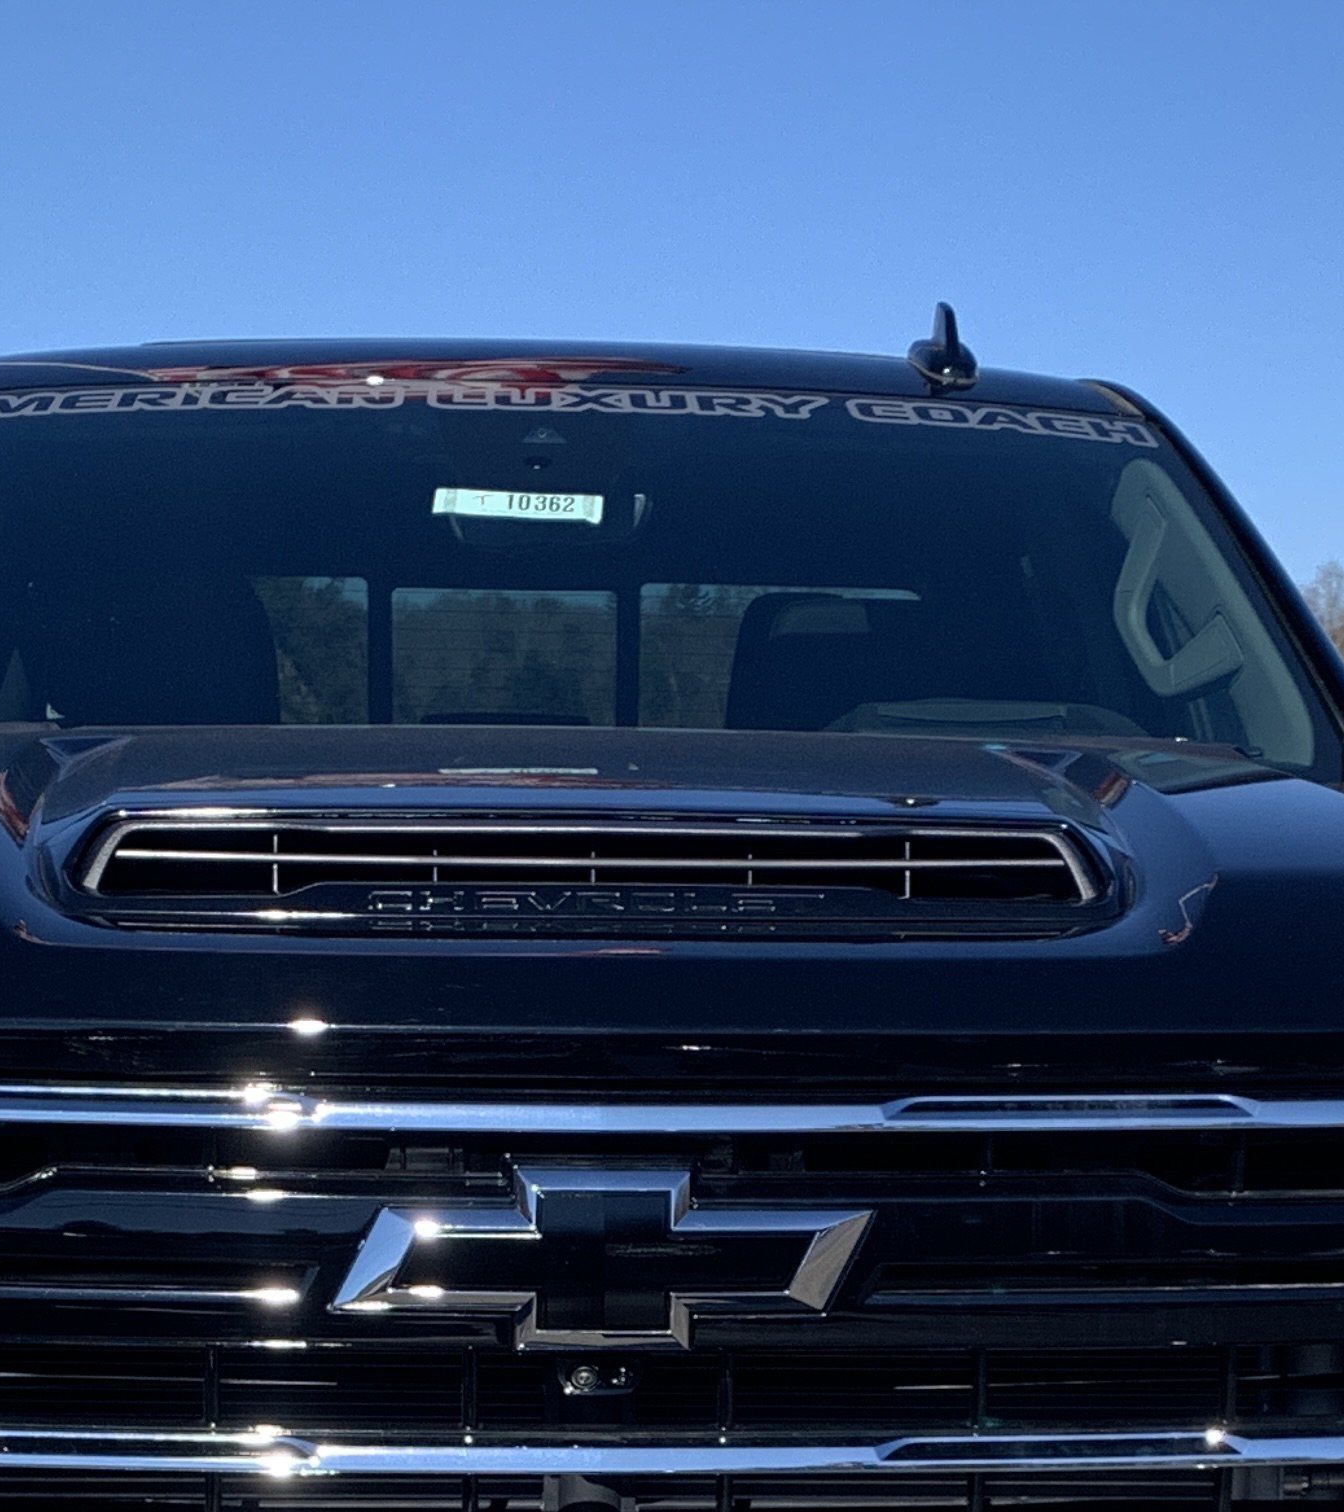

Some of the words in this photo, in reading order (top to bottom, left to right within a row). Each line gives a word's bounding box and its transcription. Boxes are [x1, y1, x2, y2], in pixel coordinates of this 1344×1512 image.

[425, 383, 829, 418] LUXURY
[846, 401, 1159, 447] COACH
[507, 493, 576, 514] 10362
